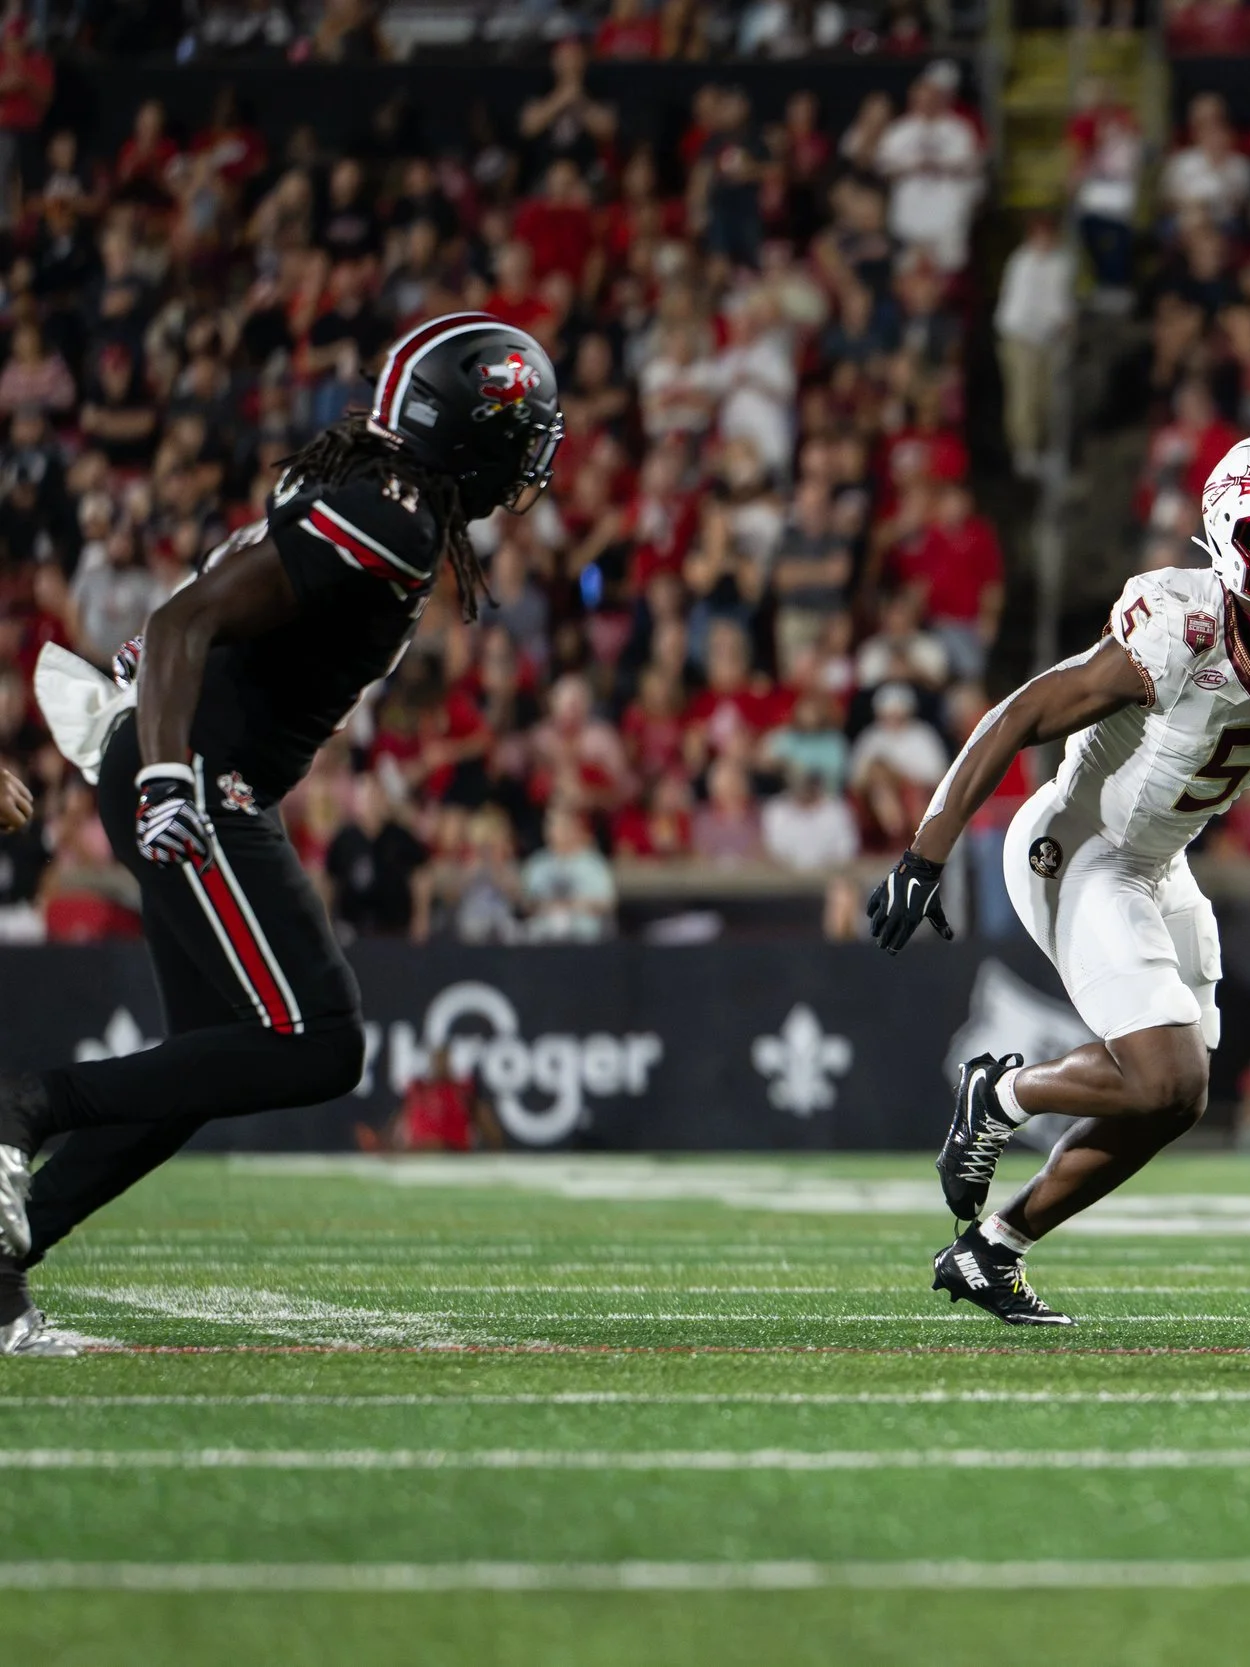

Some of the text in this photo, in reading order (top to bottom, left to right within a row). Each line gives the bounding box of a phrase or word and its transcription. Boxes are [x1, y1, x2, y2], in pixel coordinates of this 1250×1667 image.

[1121, 595, 1152, 643] 5
[1194, 673, 1223, 685] ACC
[953, 1250, 990, 1291] NIKE
